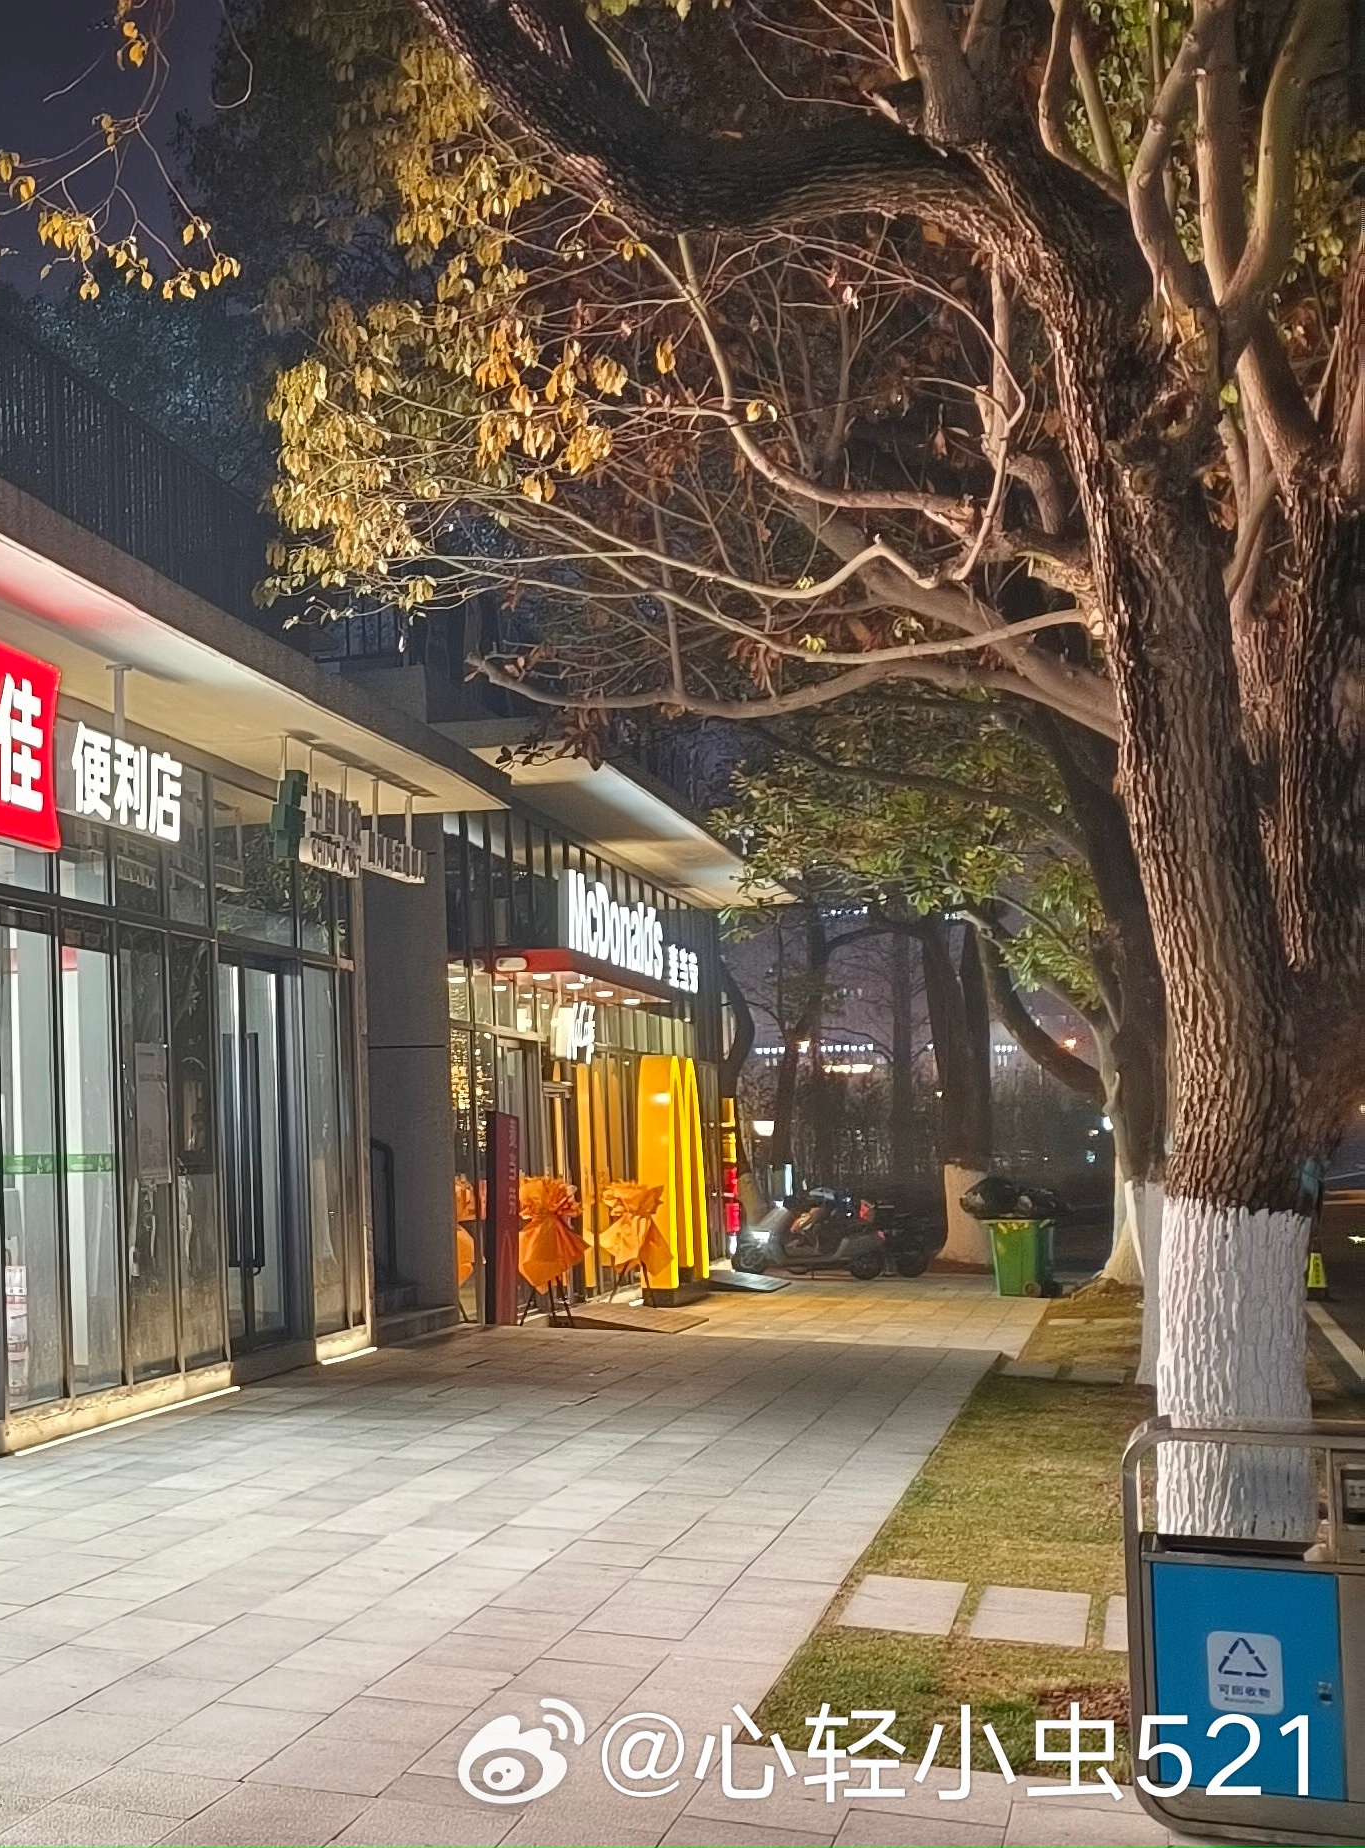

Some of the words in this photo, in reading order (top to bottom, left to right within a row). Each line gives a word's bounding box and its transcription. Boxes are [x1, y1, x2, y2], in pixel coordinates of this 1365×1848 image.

[71, 721, 183, 843] 便利店
[568, 868, 664, 981] McDonald's
[1218, 1684, 1271, 1699] 可回收物
